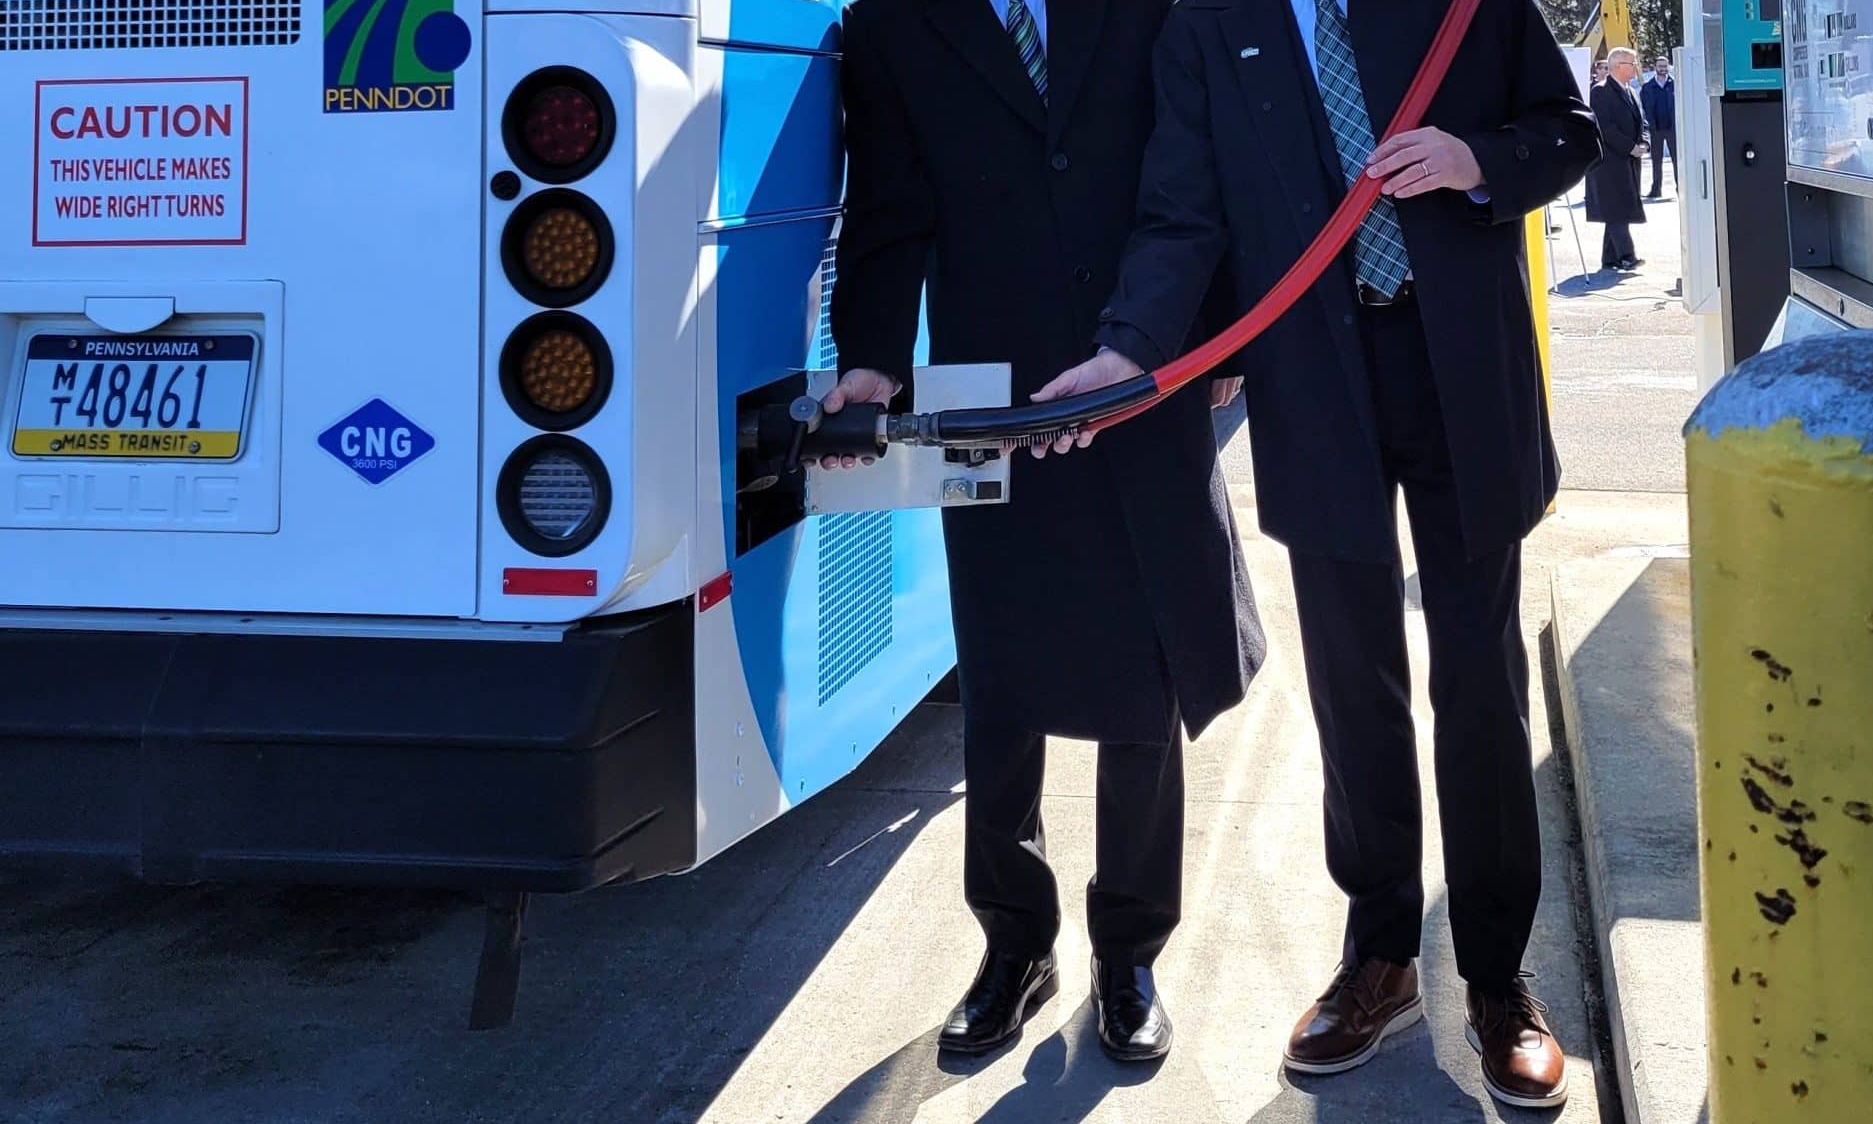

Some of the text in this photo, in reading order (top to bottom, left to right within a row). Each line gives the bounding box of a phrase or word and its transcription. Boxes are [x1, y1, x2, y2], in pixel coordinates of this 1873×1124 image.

[325, 85, 452, 111] PENNDOT
[50, 104, 232, 139] CAUTION
[50, 157, 231, 182] THIS VEHICLE MAKES
[55, 194, 225, 218] WIDE RIGHT TURNS
[85, 342, 199, 356] PENNSYLVANIA
[62, 433, 188, 451] MASS TRANSIT
[341, 426, 412, 458] CNG
[380, 459, 397, 470] PSI
